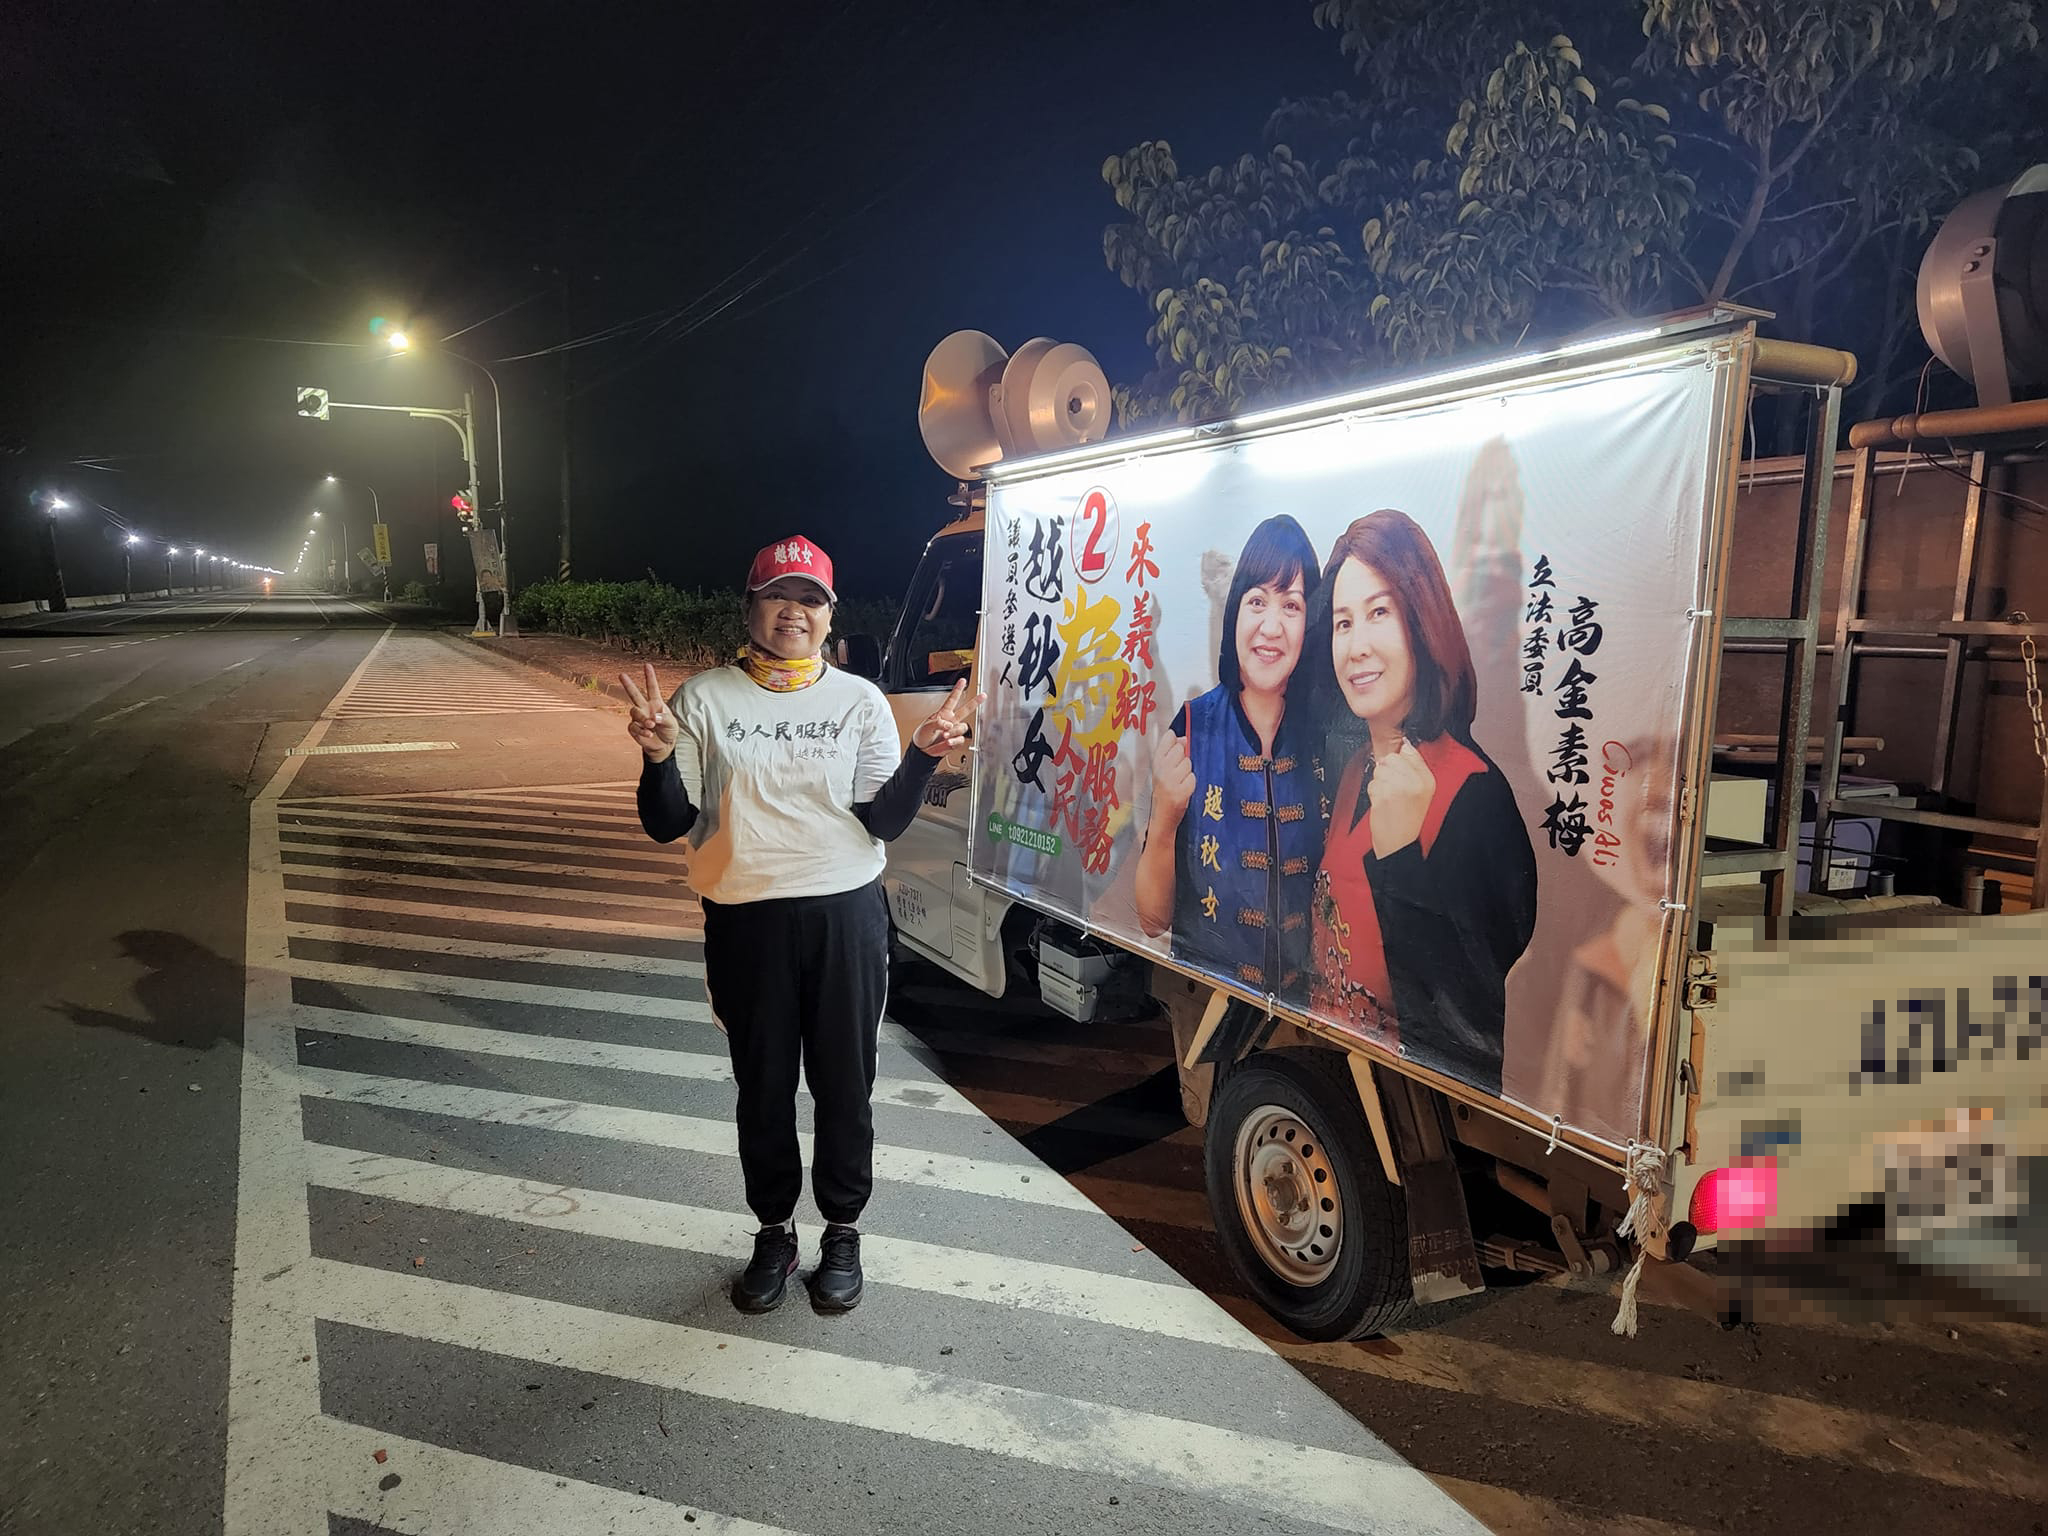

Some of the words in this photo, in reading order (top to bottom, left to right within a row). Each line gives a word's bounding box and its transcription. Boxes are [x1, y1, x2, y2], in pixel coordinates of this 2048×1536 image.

[774, 541, 813, 566] 越秋女
[1082, 492, 1107, 571] 2
[1012, 514, 1066, 793] 越秋女
[1112, 521, 1161, 737] 來義鄉
[1520, 554, 1556, 696] 立法委員
[725, 718, 841, 743] 為人民服務
[1049, 717, 1086, 843] 人民
[1539, 596, 1603, 858] 高金素梅
[988, 820, 1003, 834] LINE
[1008, 823, 1056, 854] t0921210152
[1079, 741, 1119, 875] 服務
[1200, 783, 1225, 923] 越秋女
